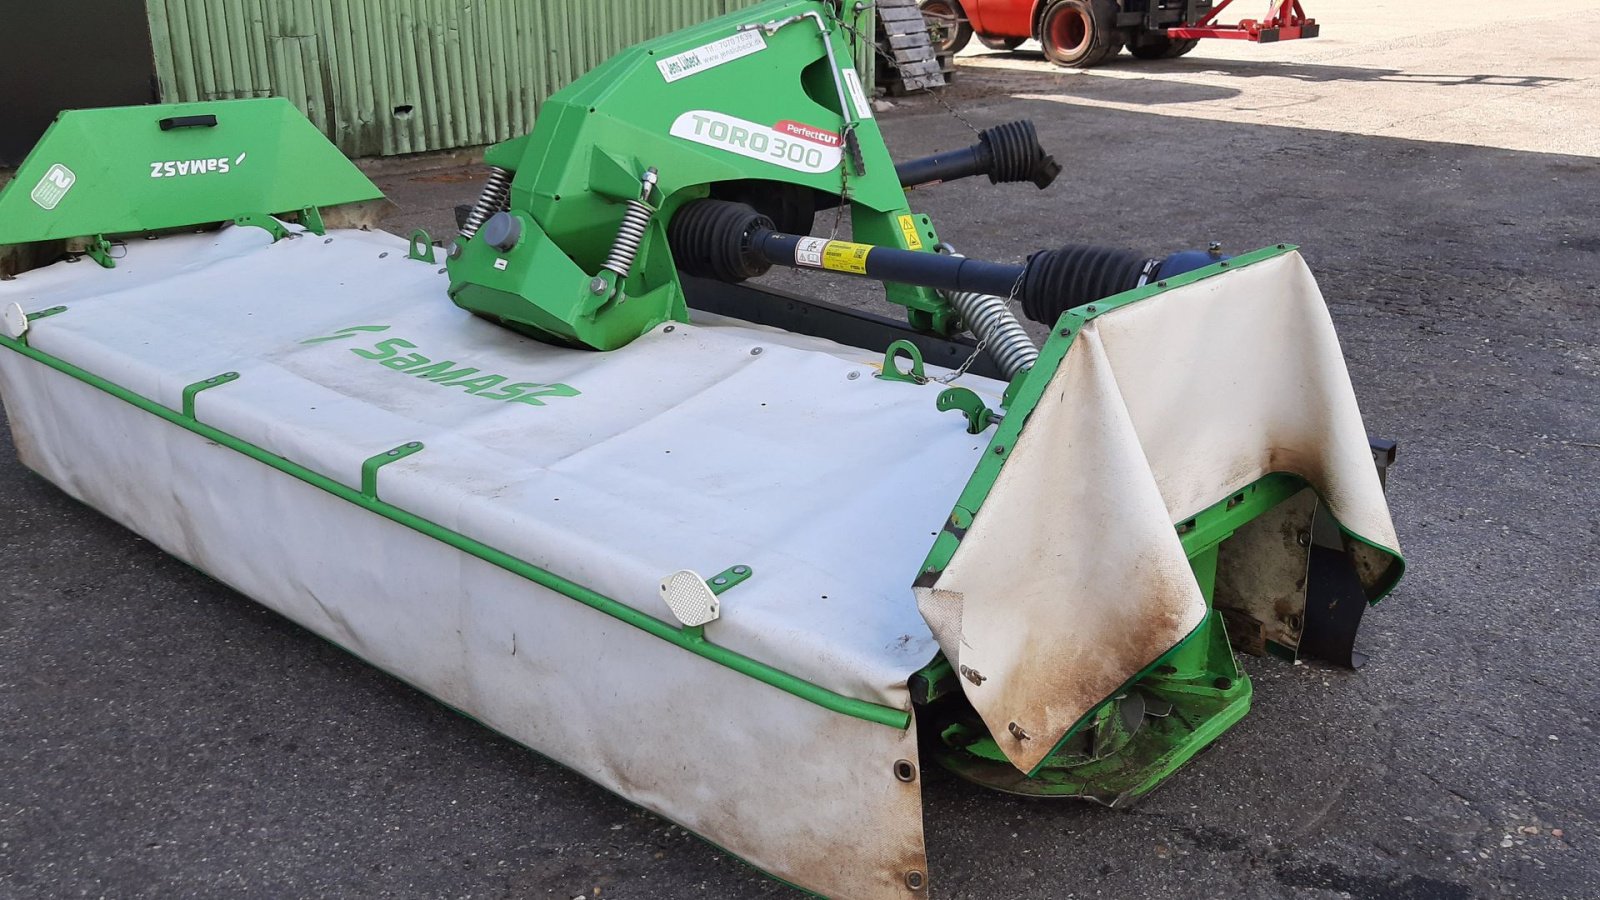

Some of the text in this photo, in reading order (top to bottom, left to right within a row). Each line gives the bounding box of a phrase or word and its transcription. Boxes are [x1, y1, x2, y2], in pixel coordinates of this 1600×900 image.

[692, 114, 823, 169] TORO 300
[786, 123, 838, 145] PerfectCUT
[150, 157, 229, 177] SaMASZ
[350, 338, 582, 406] SaMASZ
